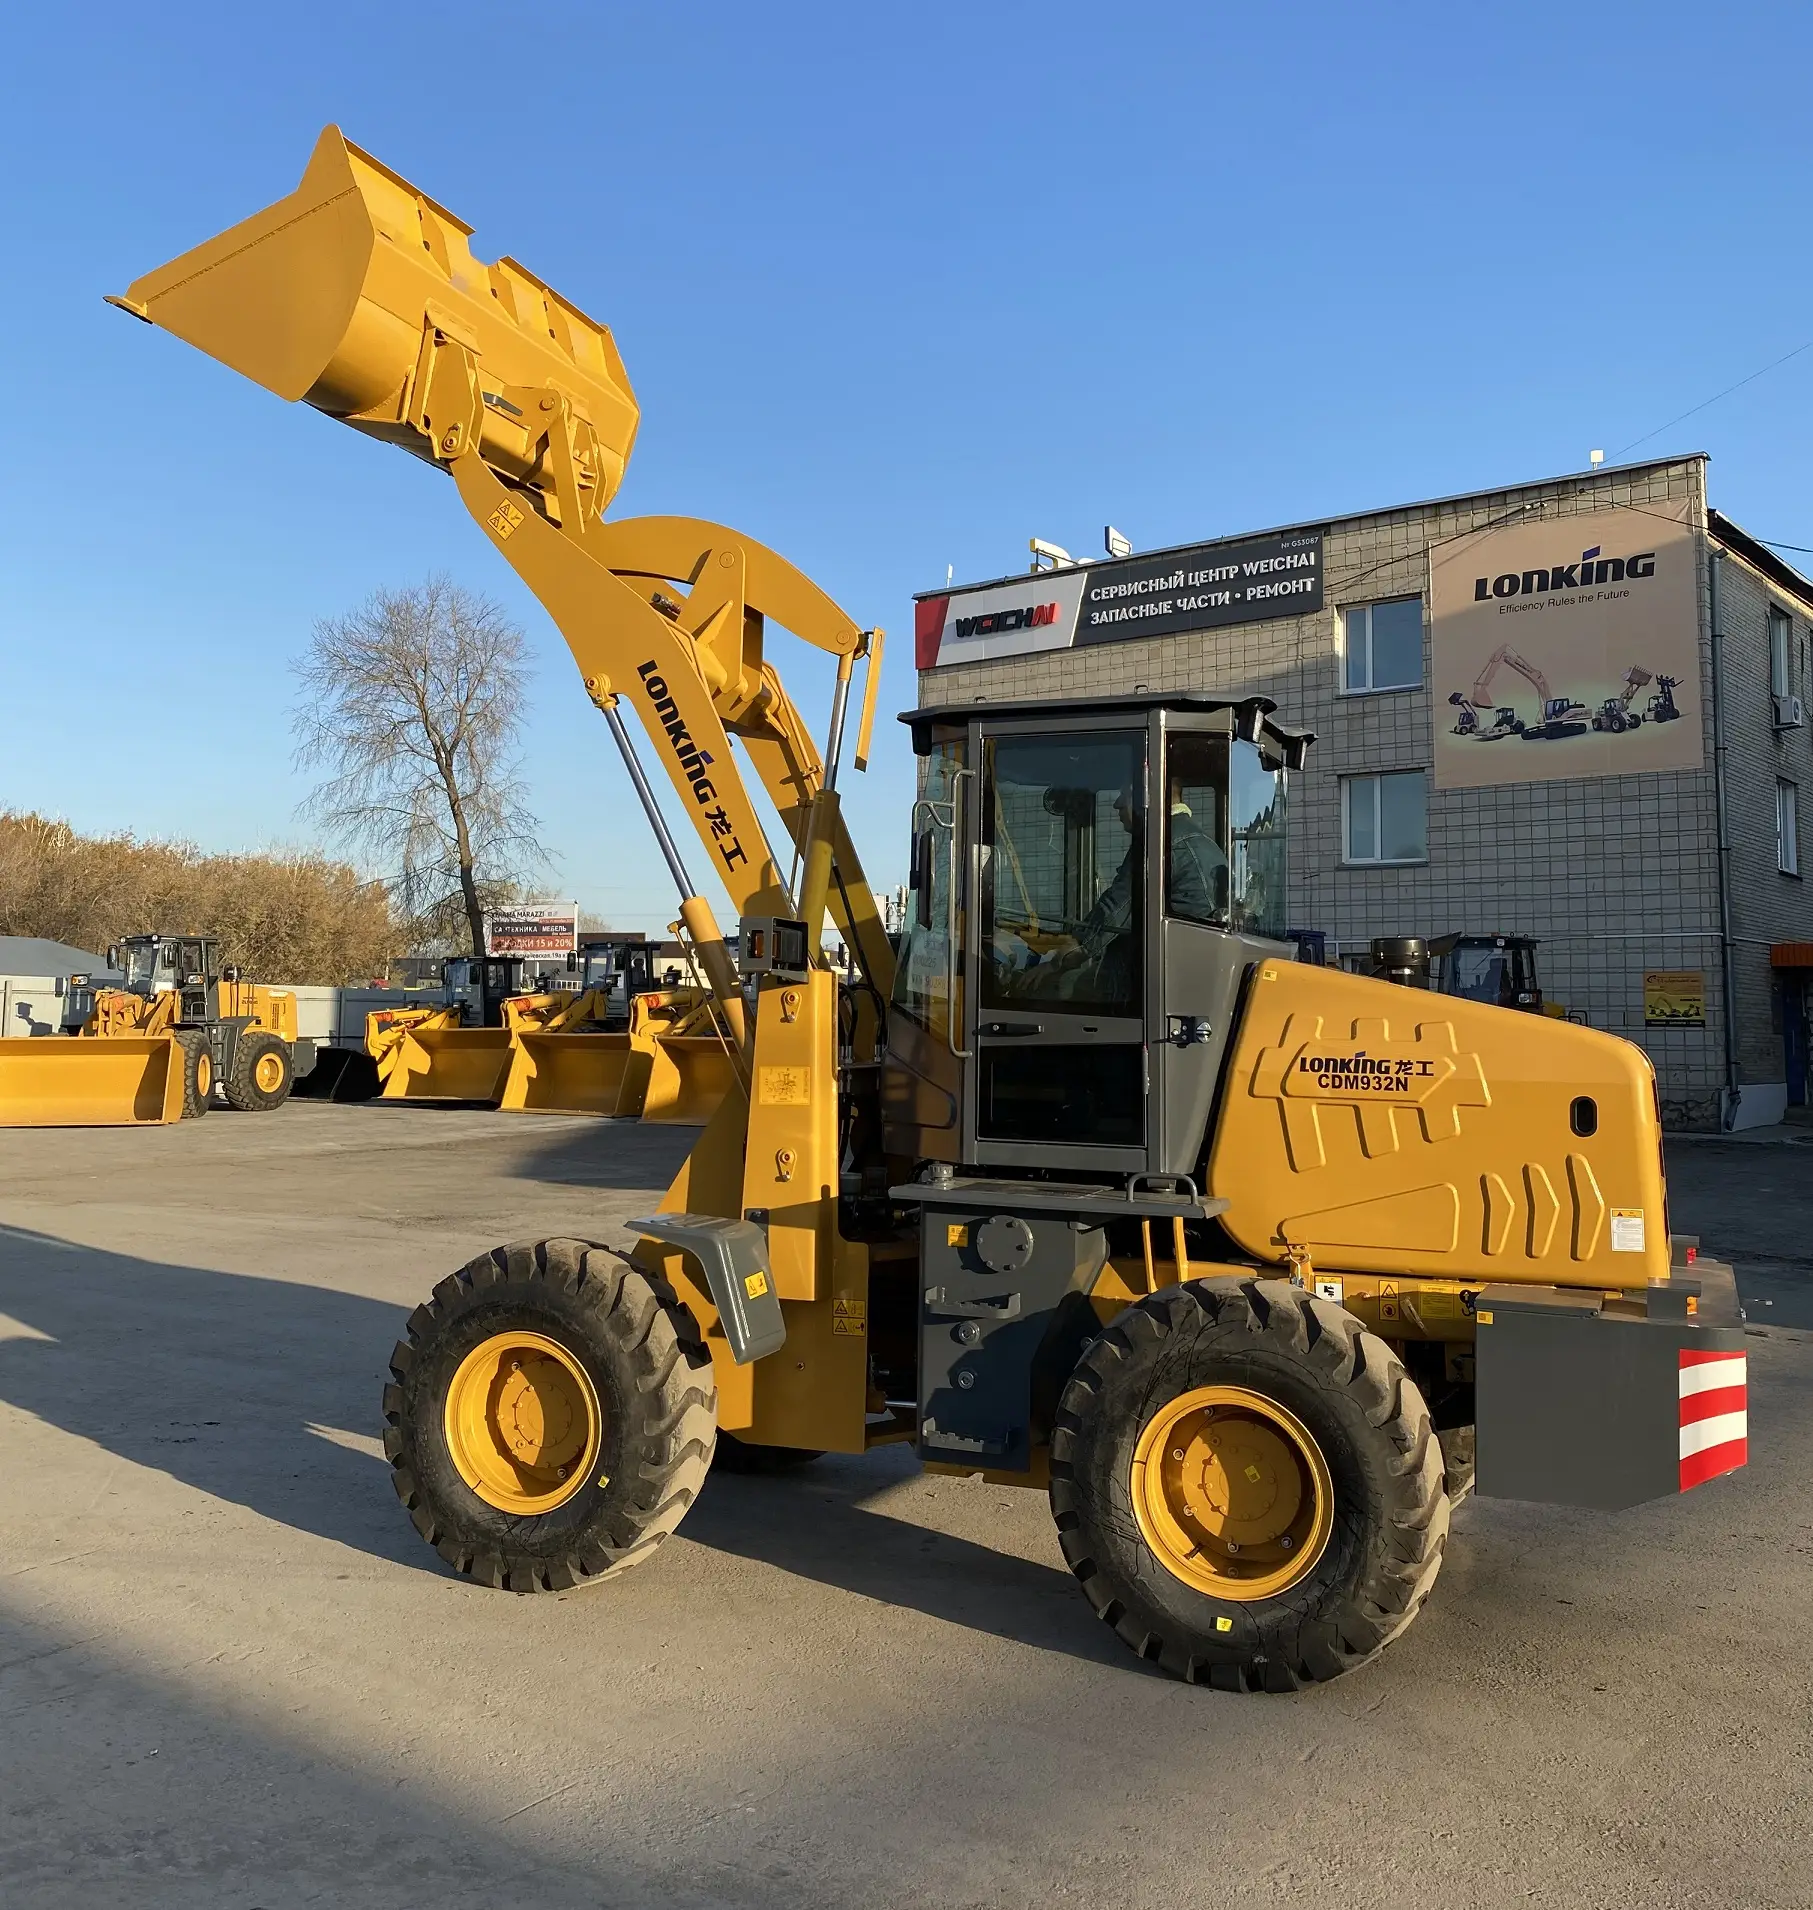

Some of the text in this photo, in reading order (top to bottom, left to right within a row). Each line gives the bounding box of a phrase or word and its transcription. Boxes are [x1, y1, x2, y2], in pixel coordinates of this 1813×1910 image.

[1090, 551, 1315, 602] СЕРВИСНЫЙ ЦЕНТР WEICHAI
[1090, 577, 1315, 626] ЗАПАСНЫЕ ЧАСТИ РЕМОНТ
[1499, 588, 1630, 615] Efficiency Rules the Future
[955, 602, 1060, 638] WEICHAI
[494, 925, 538, 933] САТЕХНИКА
[536, 939, 546, 948] 15
[554, 938, 573, 948] 20%
[1394, 1060, 1434, 1076] 龙工
[1318, 1074, 1408, 1092] CDM932N
